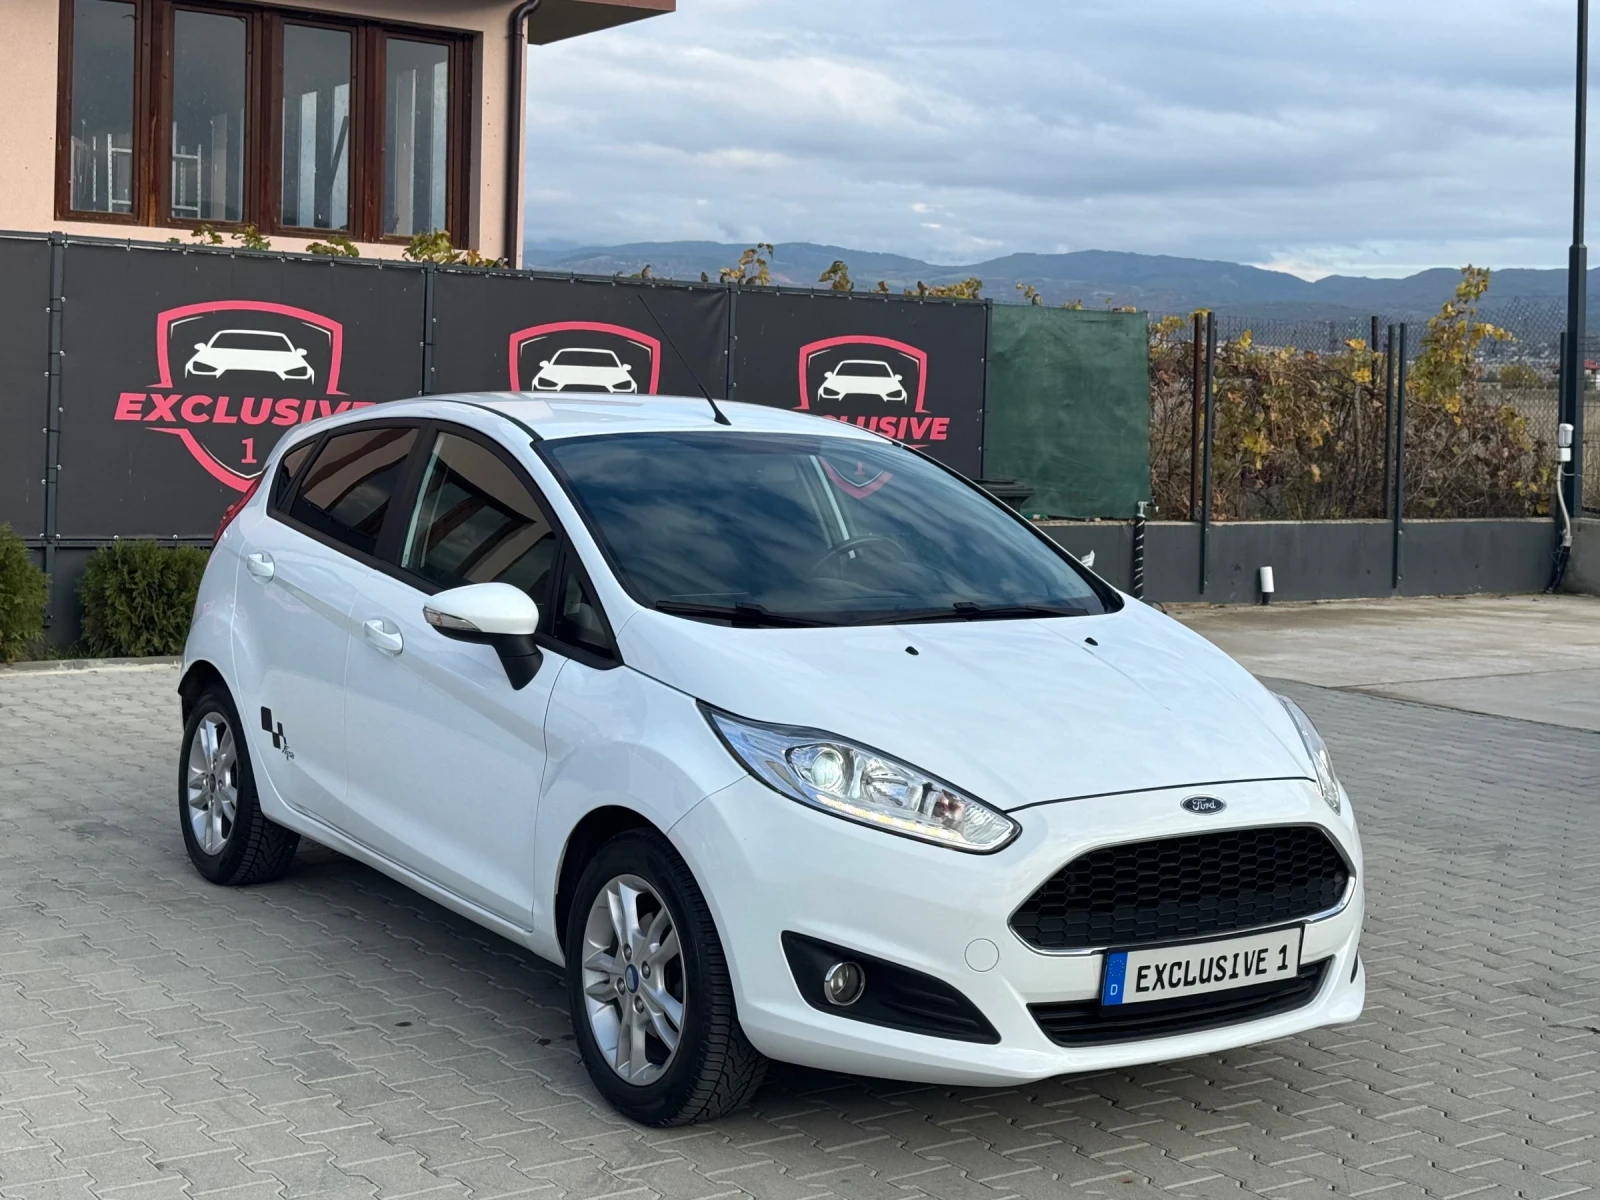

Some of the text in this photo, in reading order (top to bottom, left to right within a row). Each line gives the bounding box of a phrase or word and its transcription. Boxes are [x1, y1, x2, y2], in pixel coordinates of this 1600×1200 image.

[241, 438, 257, 464] 1
[1192, 798, 1216, 811] Ford
[1135, 944, 1289, 993] EXCLUSIVE 1
[1110, 983, 1118, 996] D
